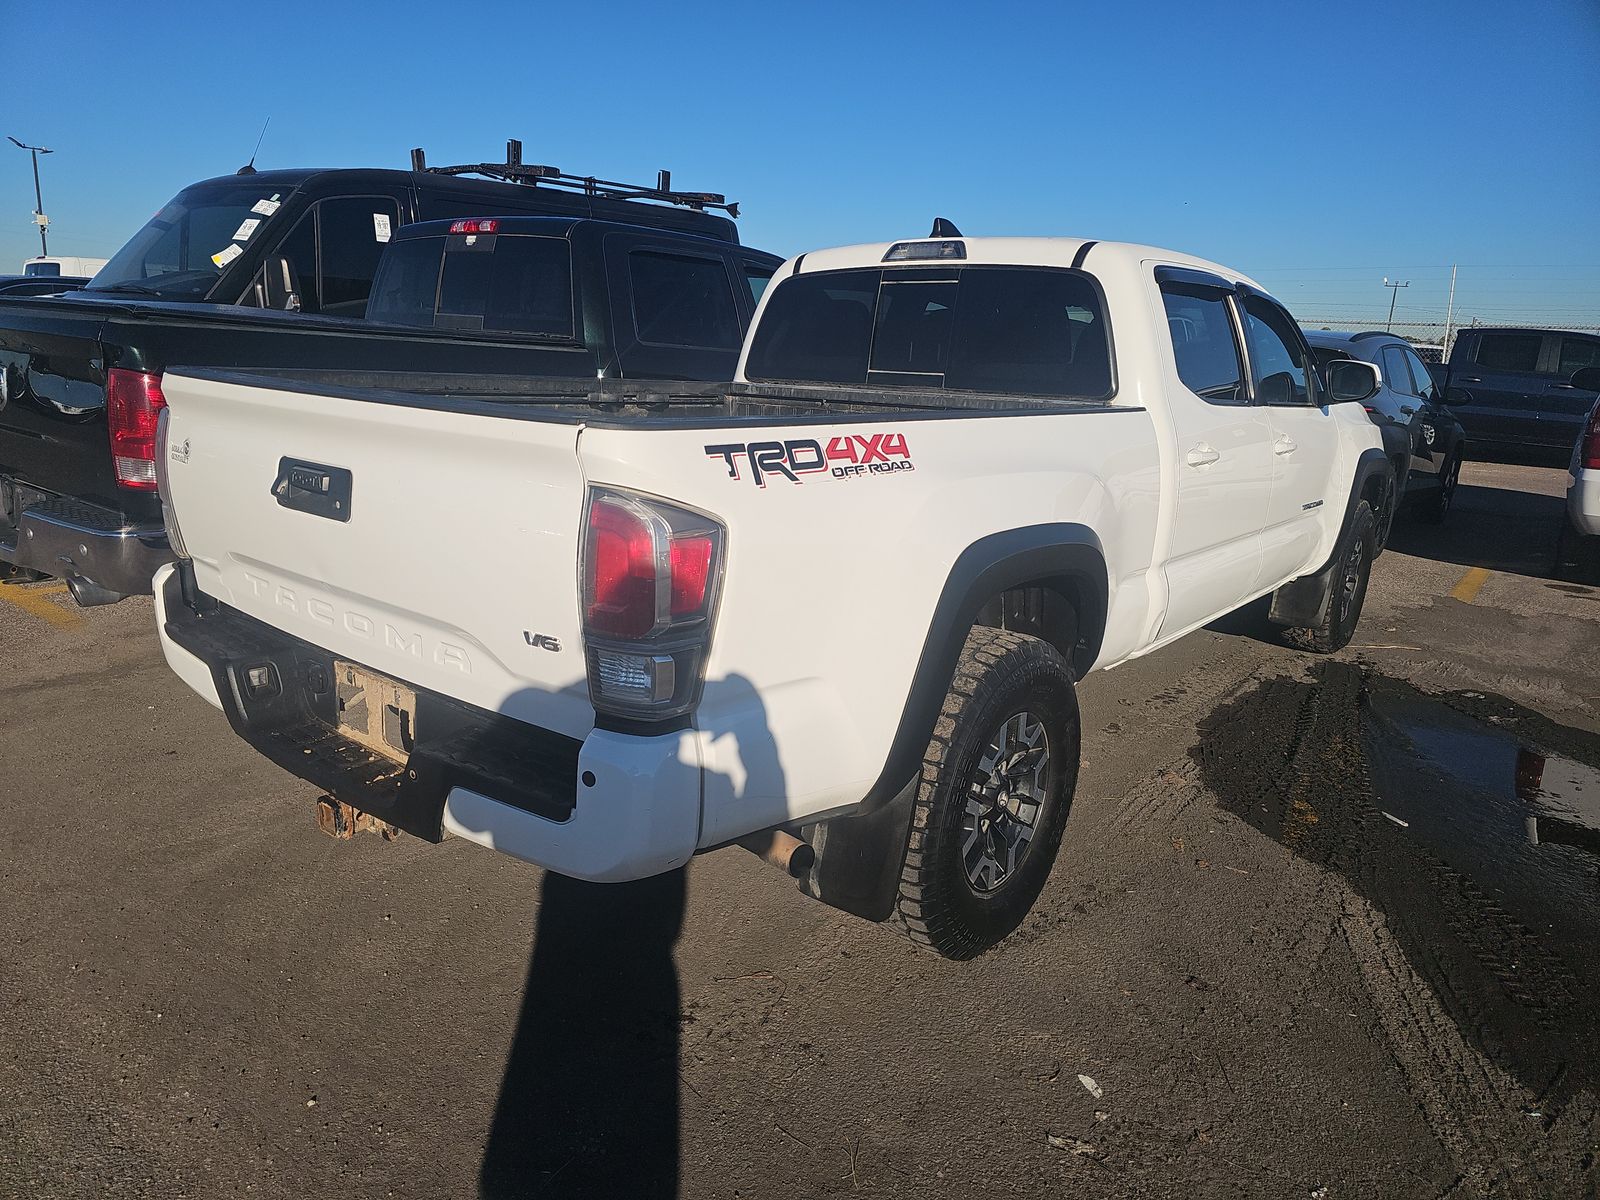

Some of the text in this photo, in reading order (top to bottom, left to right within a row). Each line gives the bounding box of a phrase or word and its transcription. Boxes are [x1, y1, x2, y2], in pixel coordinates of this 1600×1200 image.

[704, 433, 911, 488] TRD 4X4
[831, 460, 915, 480] OFF ROAD
[244, 571, 473, 674] TACOMA
[522, 629, 564, 652] V6
